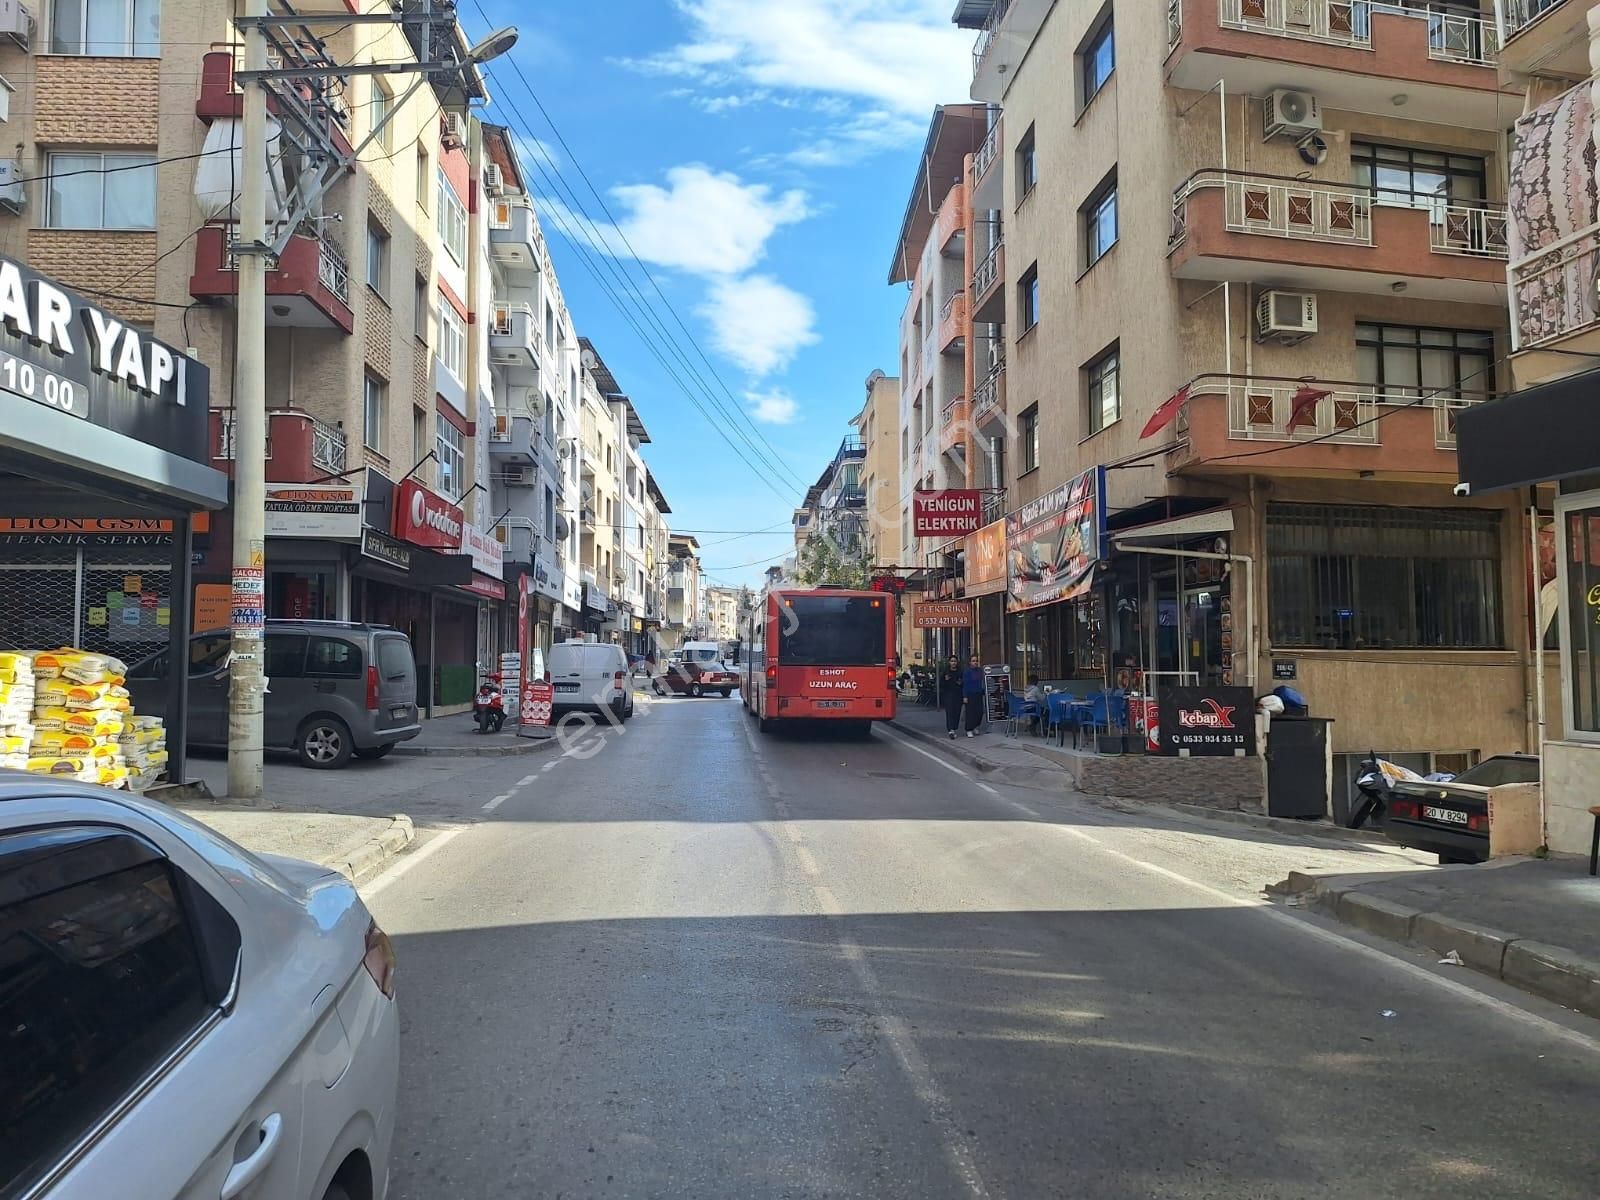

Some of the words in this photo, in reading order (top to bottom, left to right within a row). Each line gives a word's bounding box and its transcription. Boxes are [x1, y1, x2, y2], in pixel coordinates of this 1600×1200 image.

[90, 307, 187, 406] YAPI
[44, 375, 74, 411] 00
[286, 491, 317, 501] LION
[321, 492, 348, 502] GSM
[919, 496, 975, 512] YENİGÜN
[10, 518, 85, 529] LION
[96, 518, 162, 529] GSM
[917, 515, 978, 531] ELEKTRİK
[5, 533, 88, 545] TEKNİK
[96, 534, 173, 545] SERVİS
[819, 669, 846, 677] ESHOT
[809, 681, 833, 689] UZUN
[834, 681, 858, 690] ARAÇ
[1183, 735, 1203, 743] 0533
[1204, 735, 1220, 743] 934
[1221, 735, 1232, 743] 35
[1234, 735, 1244, 743] 13
[1426, 808, 1437, 817] 20
[1439, 809, 1445, 818] V
[1447, 811, 1466, 823] 8294
